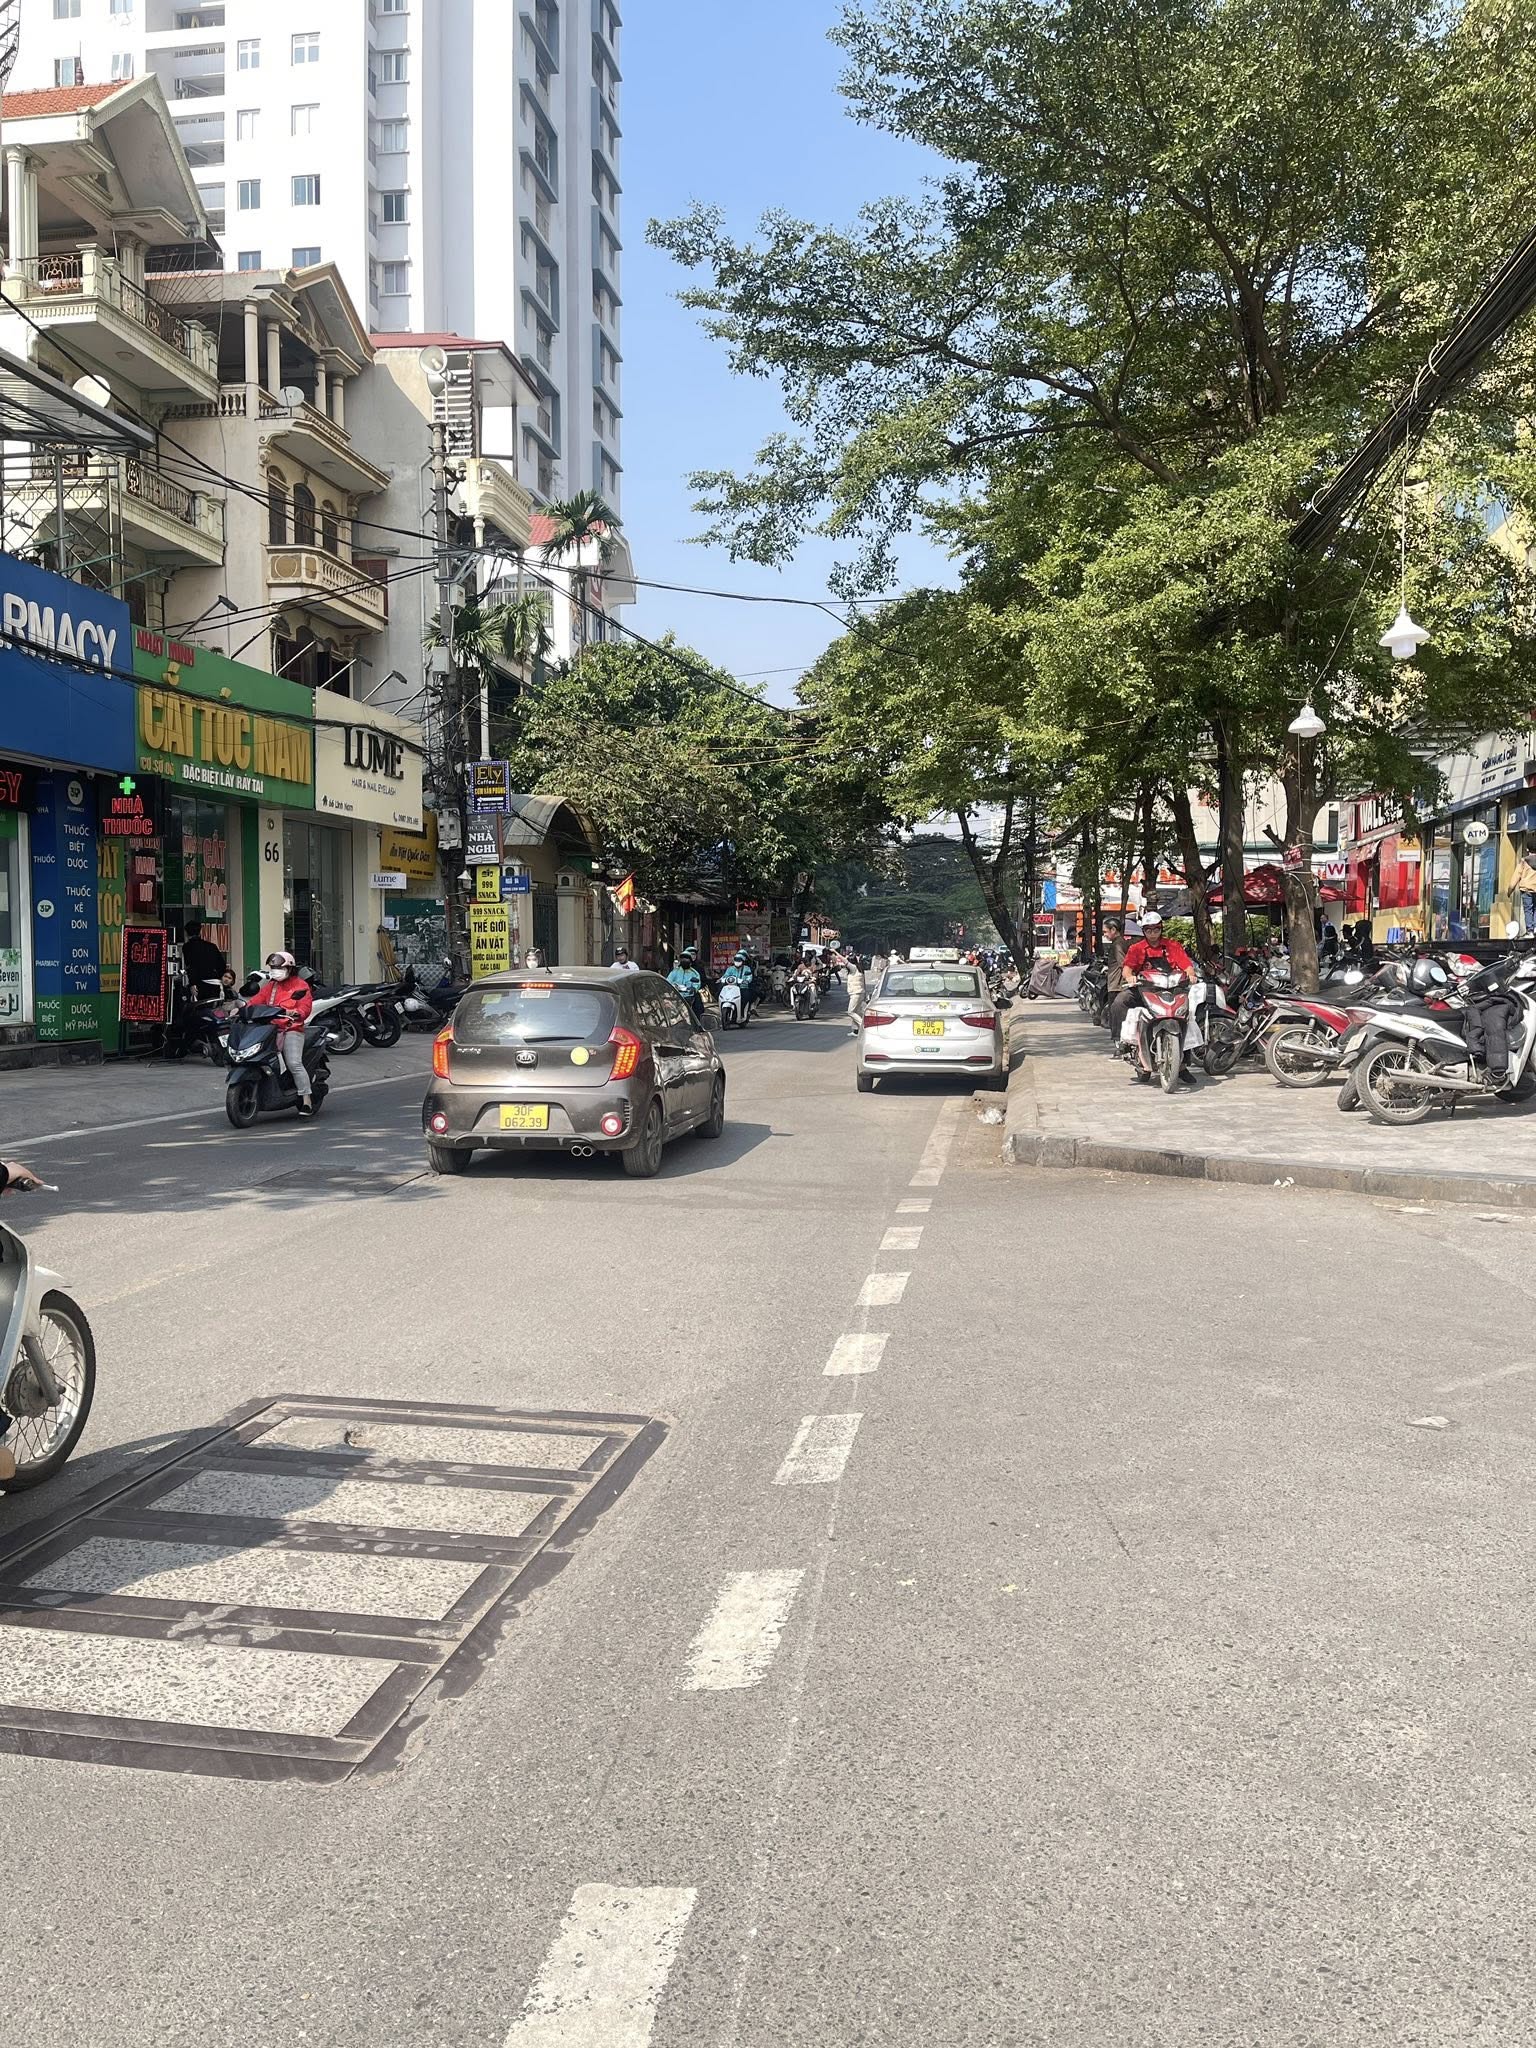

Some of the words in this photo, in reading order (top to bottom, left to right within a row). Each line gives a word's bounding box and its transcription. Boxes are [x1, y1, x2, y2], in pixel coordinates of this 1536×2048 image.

[0, 592, 117, 680] RMACY
[167, 641, 195, 668] MINH
[254, 714, 312, 785] NAM
[343, 726, 404, 780] LUME
[183, 763, 201, 784] ĐẶC
[201, 766, 219, 788] BIỆT
[236, 773, 251, 791] RÁY
[251, 779, 264, 794] TAI
[111, 795, 144, 814] NHÀ
[64, 824, 90, 837] THUỐC
[103, 815, 153, 835] THUỐC
[468, 830, 494, 842] NHÀ
[1467, 829, 1487, 839] ATM
[69, 841, 86, 853] BIỆT
[264, 842, 280, 863] 66
[33, 854, 56, 864] THUỐC
[67, 858, 89, 870] DƯỢC
[1327, 863, 1345, 875] W
[374, 874, 397, 883] Lume
[481, 880, 494, 889] 999
[65, 886, 92, 897] THUỐC
[478, 891, 497, 899] SNACK
[483, 907, 505, 915] SNACK
[71, 920, 88, 930] ĐƠN
[473, 917, 488, 933] THẾ
[490, 920, 507, 933] GIỚI
[72, 949, 89, 959] ĐƠN
[131, 933, 158, 964] CẮT
[64, 964, 79, 975] CÁC
[79, 964, 97, 976] VIỆN
[75, 981, 88, 991] TW
[37, 1000, 60, 1010] THUỐC
[71, 1004, 92, 1015] DƯỢC
[126, 993, 160, 1016] NAM
[519, 1054, 533, 1062] KIA
[514, 1105, 534, 1116] 30F
[504, 1117, 542, 1128] 062.39
